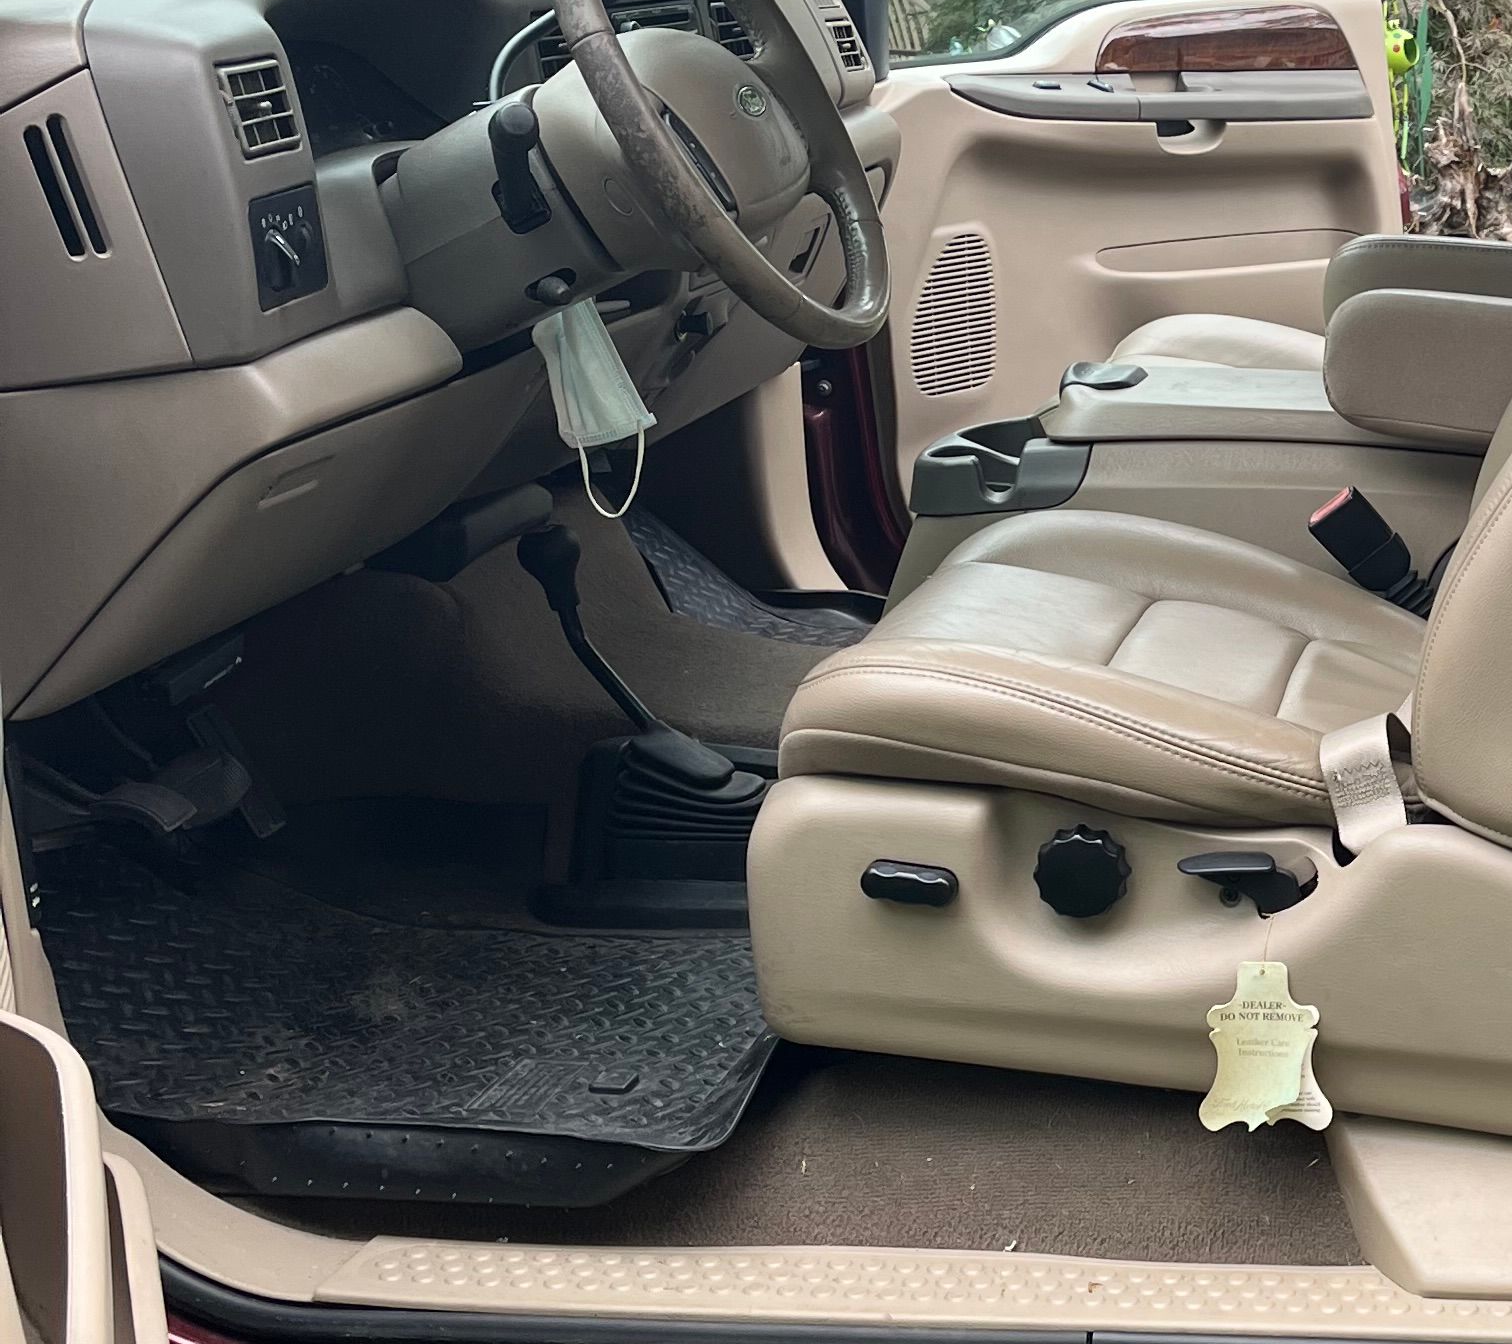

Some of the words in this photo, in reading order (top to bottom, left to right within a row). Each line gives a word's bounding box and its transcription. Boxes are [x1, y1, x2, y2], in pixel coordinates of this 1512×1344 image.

[1220, 1012, 1235, 1021] DO
[1239, 1012, 1260, 1021] NOT
[1263, 1013, 1304, 1022] REMOVE
